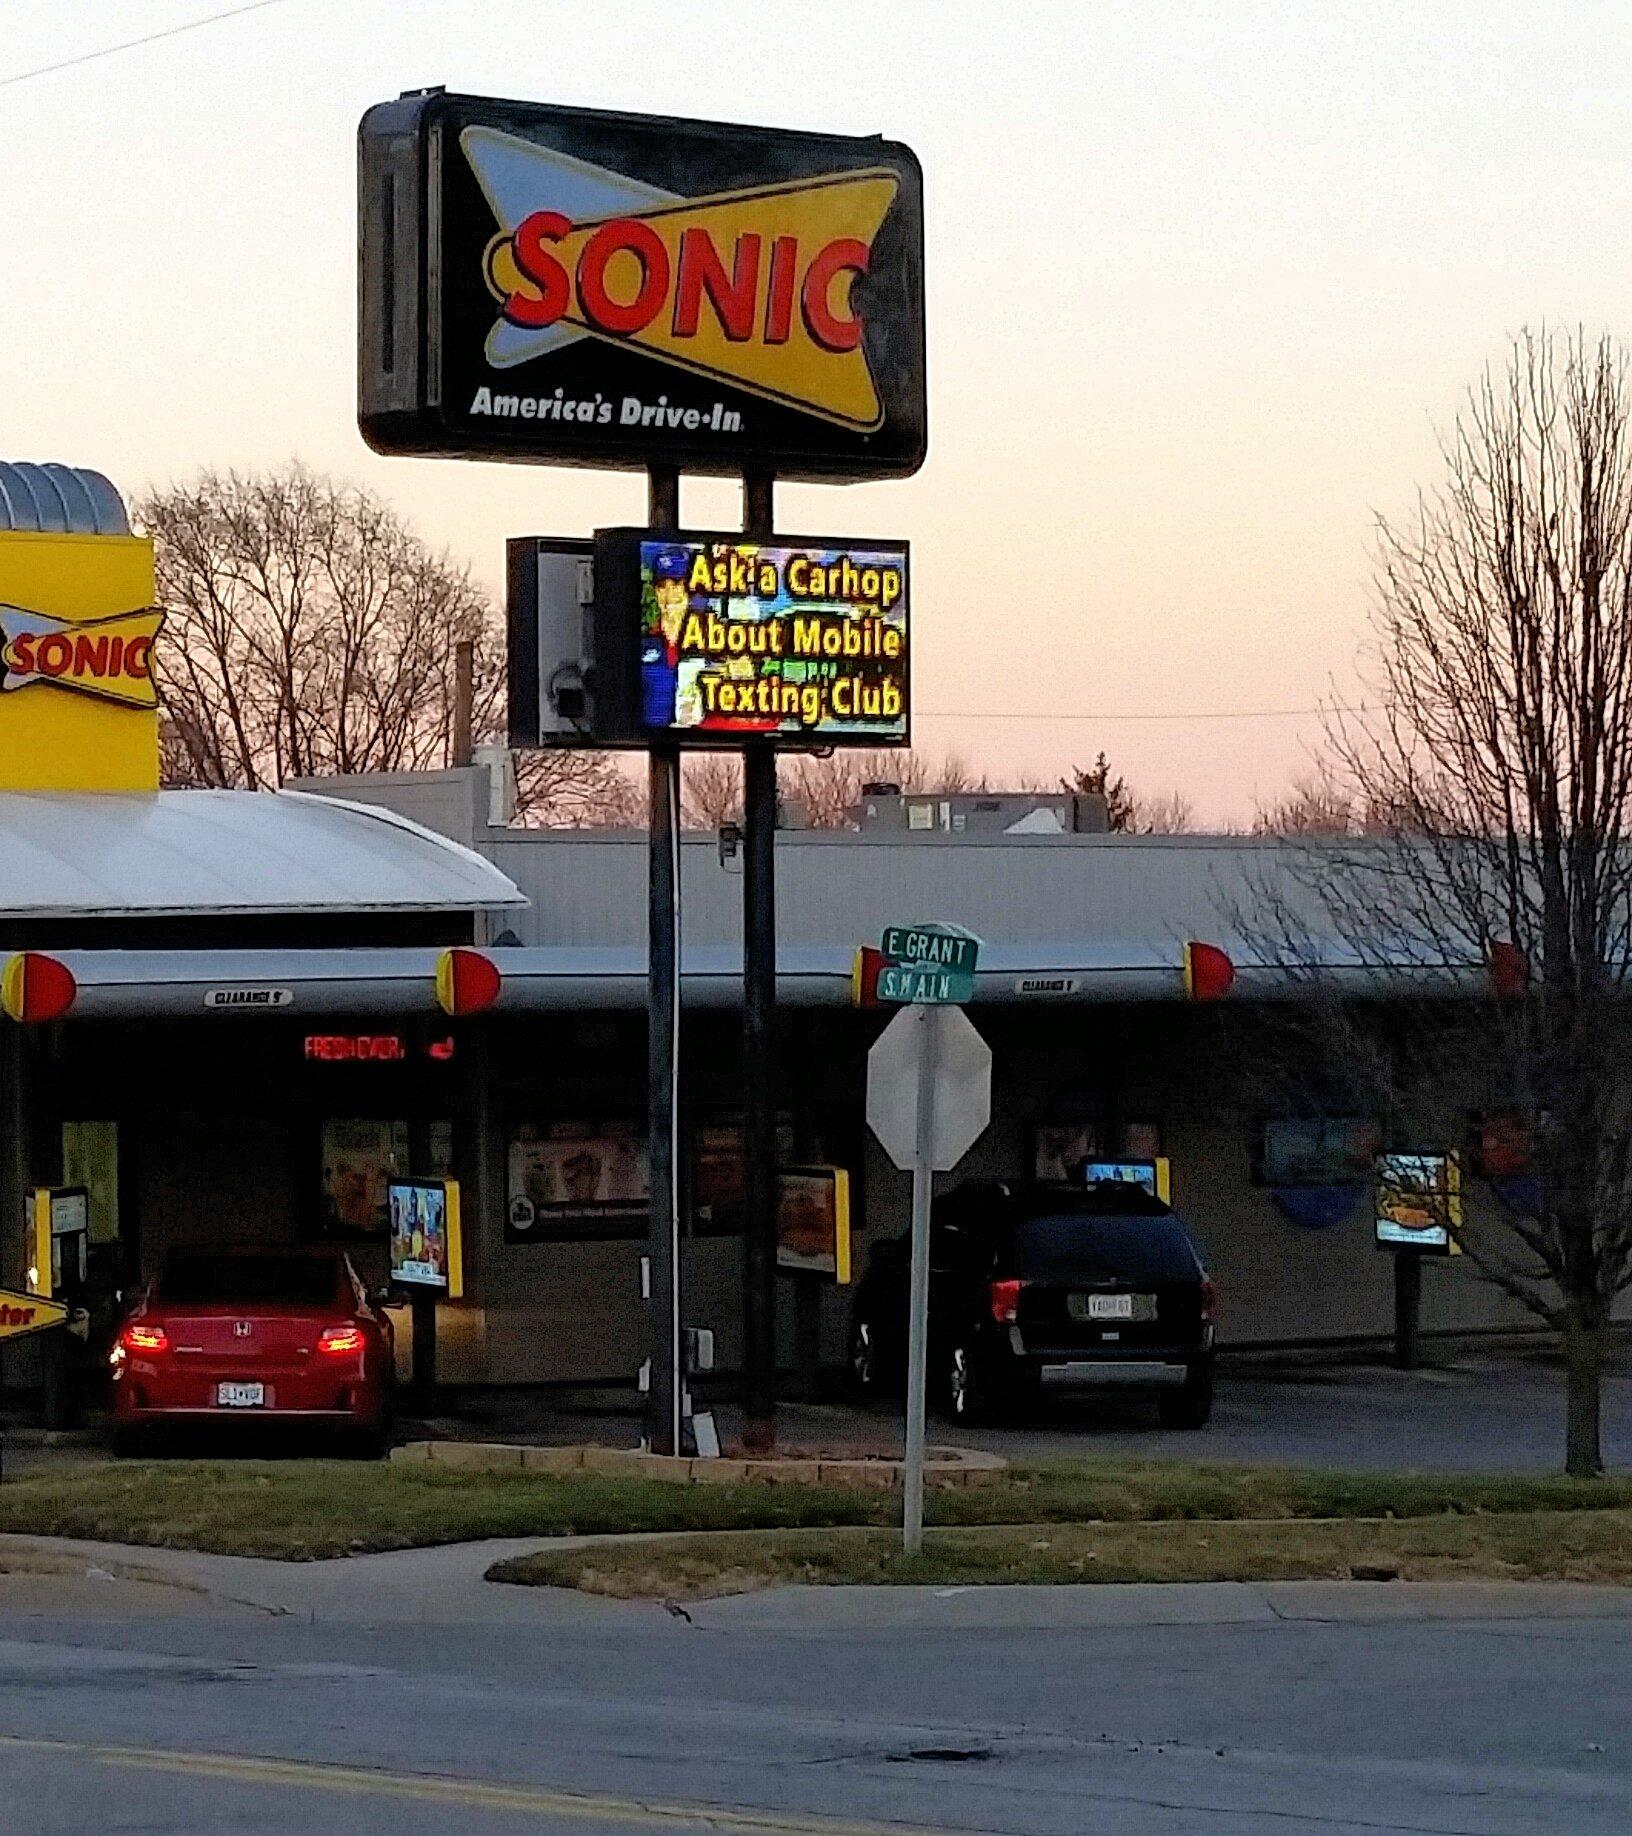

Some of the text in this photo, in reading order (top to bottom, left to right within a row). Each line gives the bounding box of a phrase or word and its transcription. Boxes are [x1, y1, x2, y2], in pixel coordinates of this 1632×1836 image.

[500, 210, 870, 354] SONIC
[469, 386, 613, 424] America's
[688, 554, 901, 607] Ask a Carhop
[10, 632, 153, 679] SONIC
[682, 615, 901, 658] About Mobile
[702, 677, 901, 722] Texting Club
[906, 933, 966, 965] GRANT
